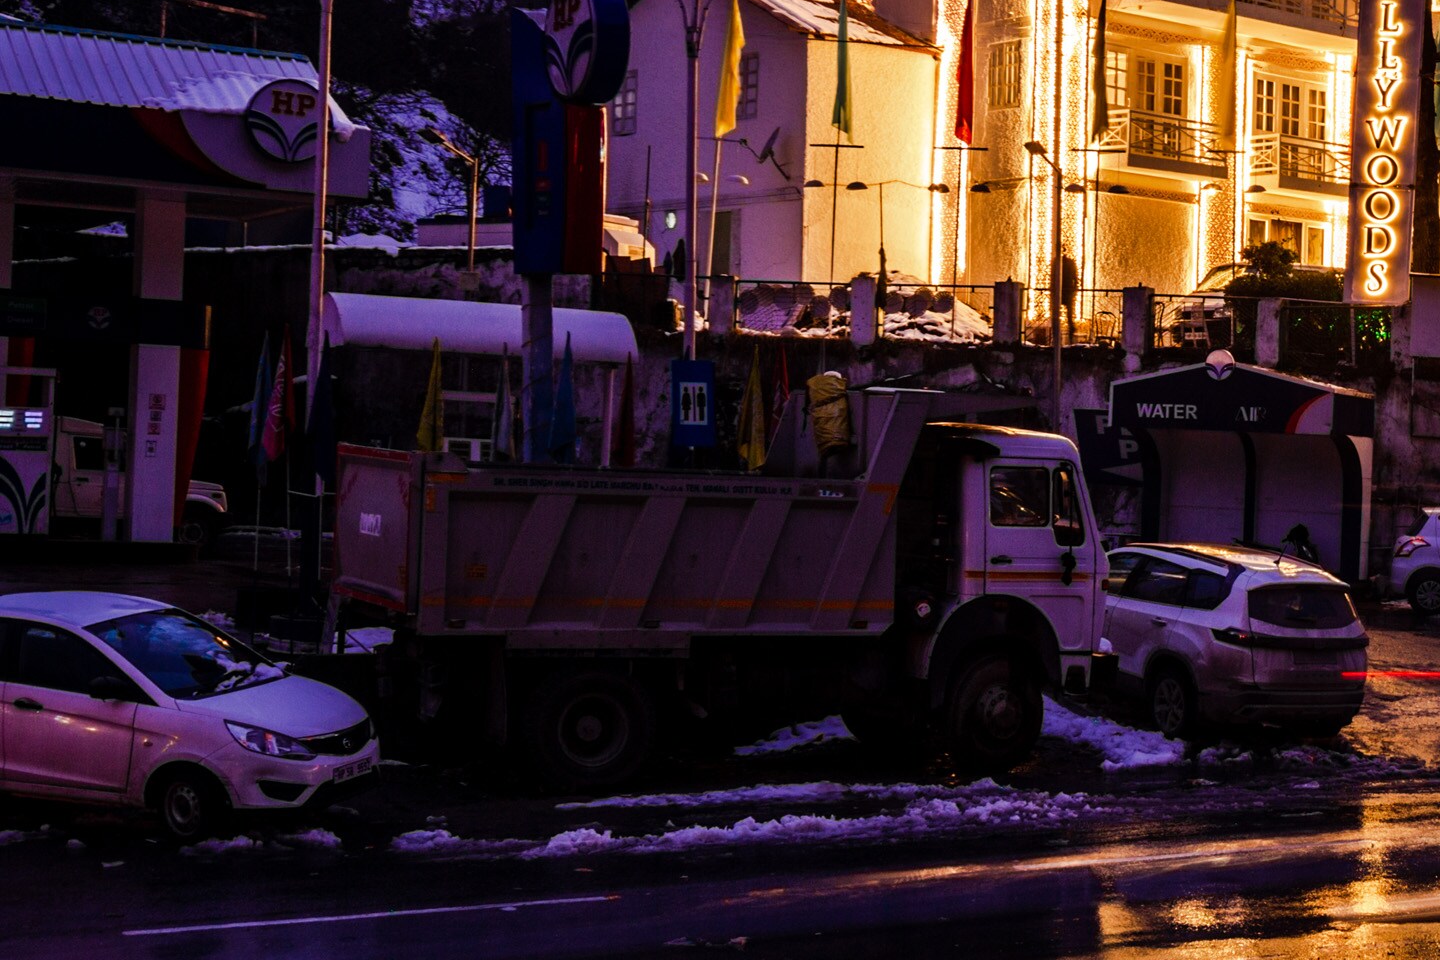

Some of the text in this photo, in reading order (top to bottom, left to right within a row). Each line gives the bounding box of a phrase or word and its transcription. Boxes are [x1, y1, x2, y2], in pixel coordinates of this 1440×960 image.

[271, 90, 316, 116] HP
[1136, 402, 1198, 420] WATER
[590, 480, 609, 489] LATE
